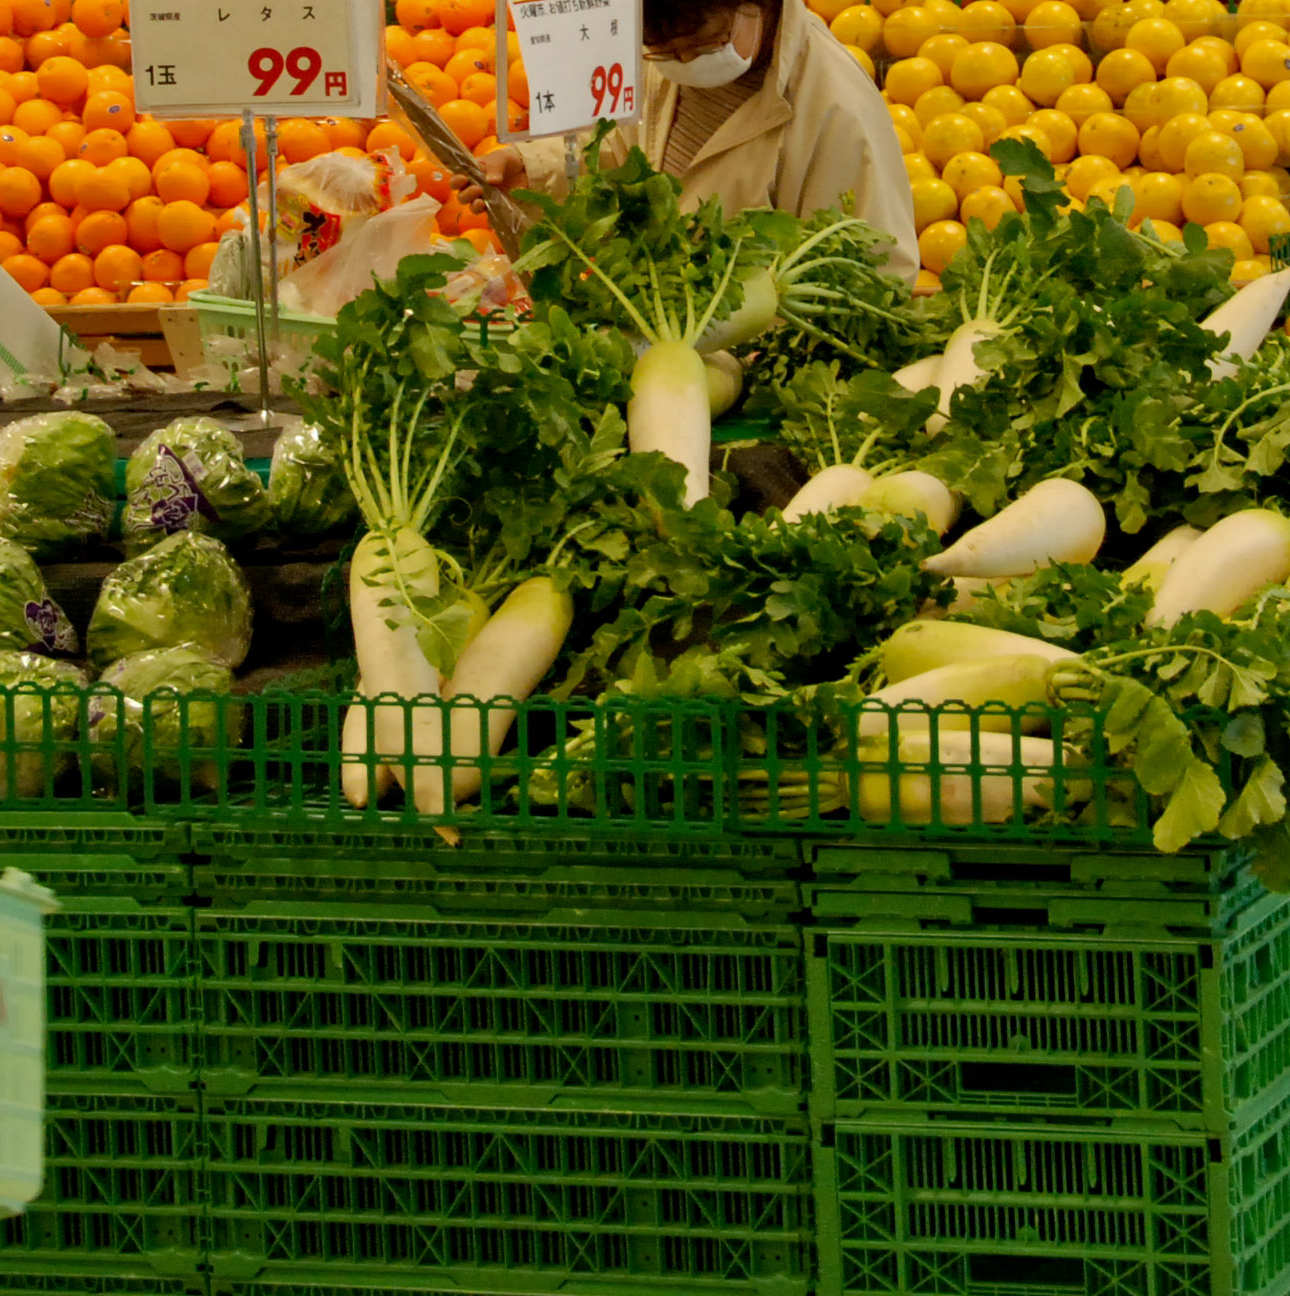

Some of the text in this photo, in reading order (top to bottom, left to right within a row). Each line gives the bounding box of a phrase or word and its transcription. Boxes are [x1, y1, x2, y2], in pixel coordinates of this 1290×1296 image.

[149, 6, 316, 22] 茨城県産 レタス
[145, 47, 347, 96] 1玉 99円
[535, 62, 634, 117] 1本 99円
